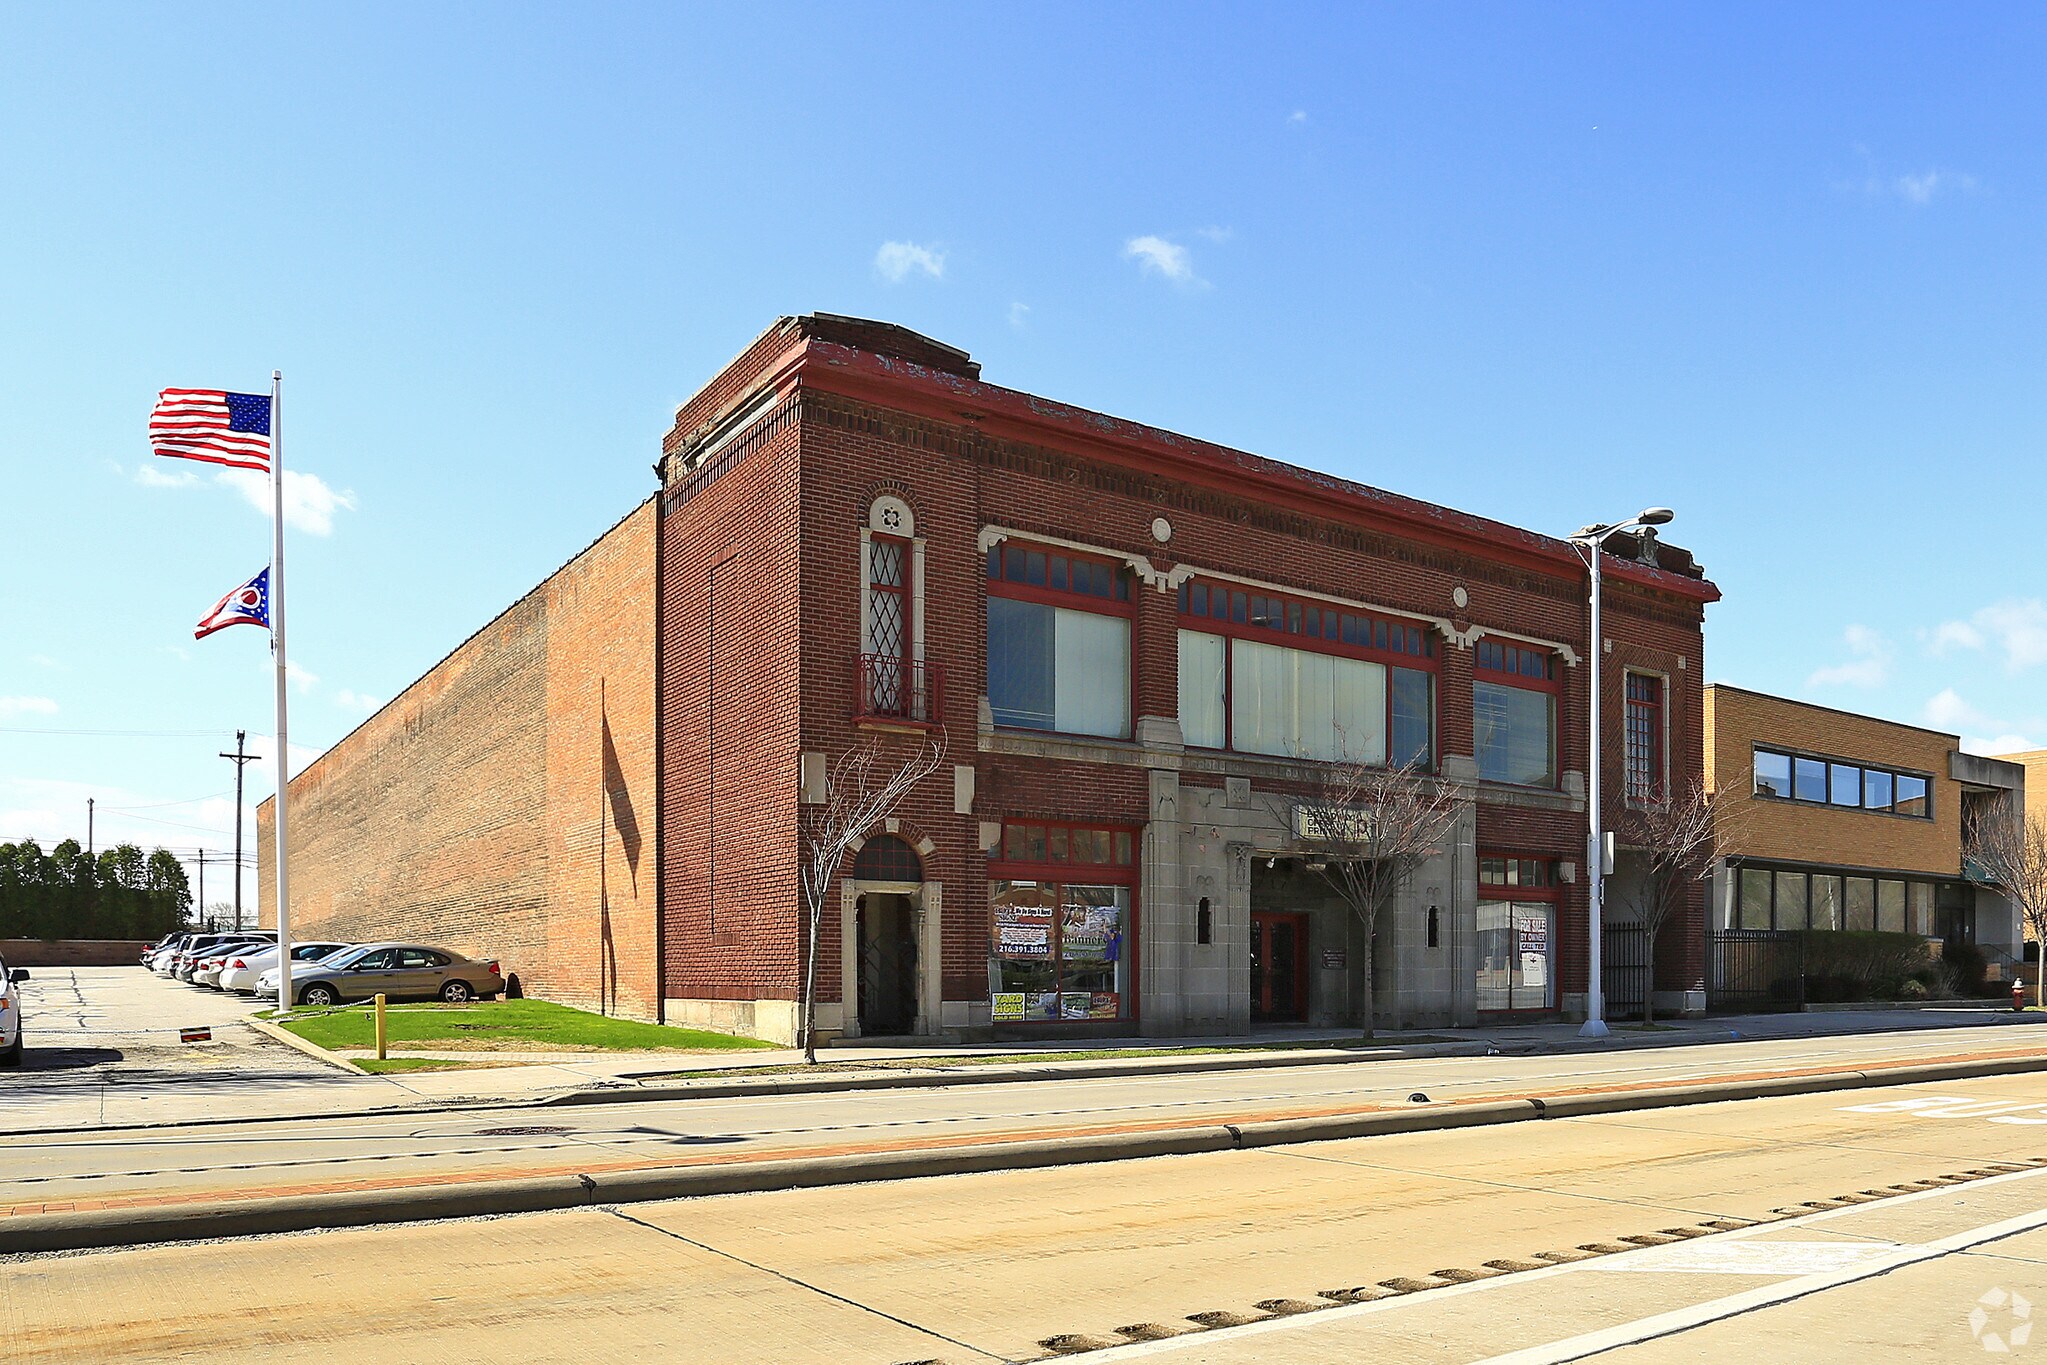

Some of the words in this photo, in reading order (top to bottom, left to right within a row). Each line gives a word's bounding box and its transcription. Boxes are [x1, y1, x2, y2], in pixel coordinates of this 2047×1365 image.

[1520, 919, 1531, 932] FOR
[1532, 920, 1546, 932] SALE
[1520, 933, 1527, 941] BY
[1528, 933, 1546, 942] OWNER
[999, 945, 1048, 953] 216.391.3804
[995, 994, 1023, 1003] YARD
[994, 1003, 1023, 1013] SIGNS
